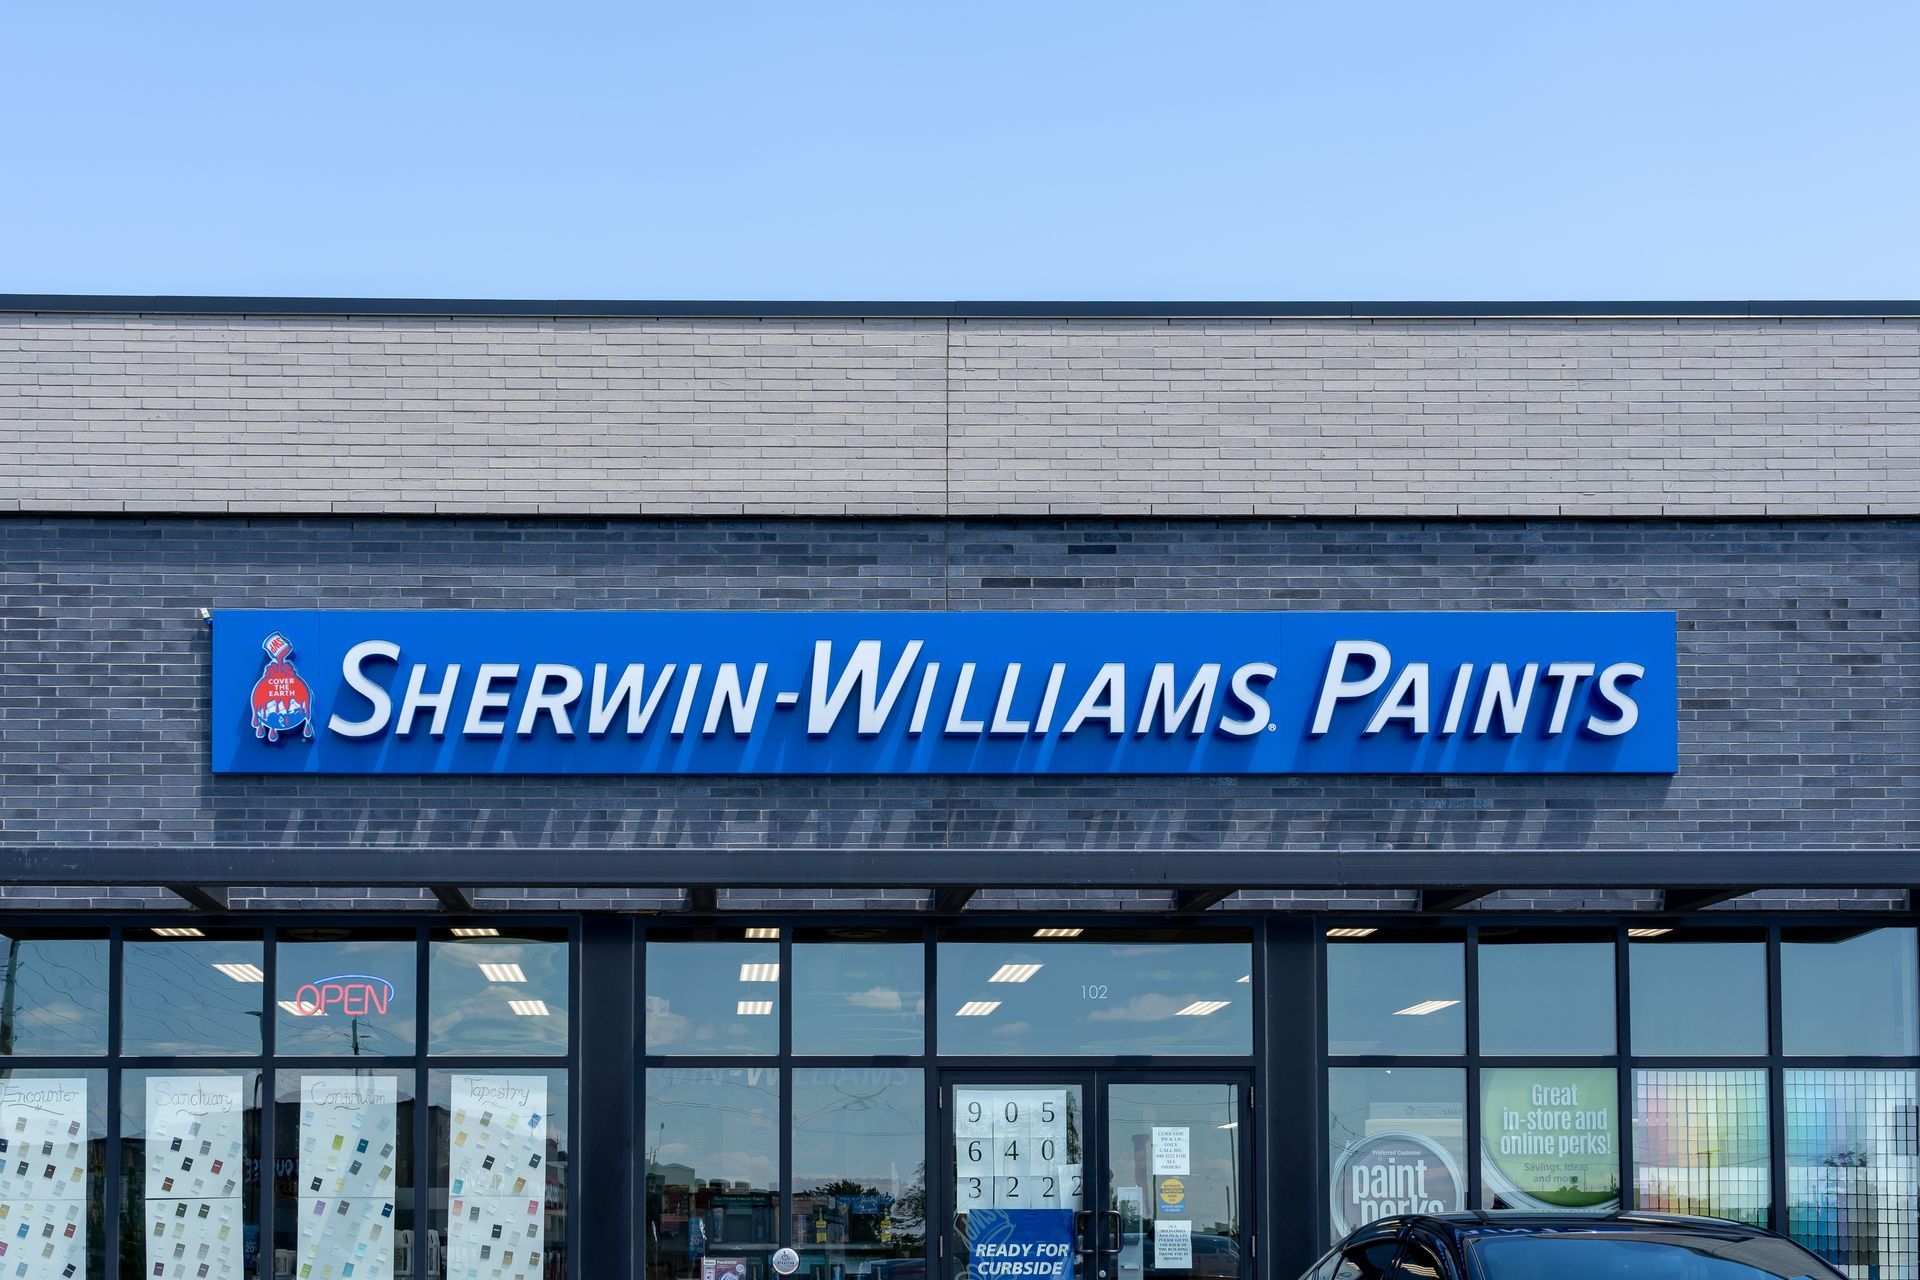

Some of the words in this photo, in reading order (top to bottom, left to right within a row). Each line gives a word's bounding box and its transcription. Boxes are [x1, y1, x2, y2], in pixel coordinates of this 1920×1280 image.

[1311, 639, 1646, 737] PAINTS
[295, 984, 388, 1015] OPEN
[1081, 985, 1109, 999] 102
[1, 1083, 80, 1103] Encounter
[155, 1081, 233, 1113] Sanctuary
[310, 1081, 386, 1105] Continuum
[463, 1076, 530, 1107] Tapestry
[1532, 1084, 1578, 1106] Great
[1503, 1107, 1571, 1131] in-store
[1575, 1107, 1608, 1130] and
[1500, 1131, 1555, 1155] online
[1558, 1132, 1611, 1158] perks!
[1524, 1162, 1562, 1172] Savings,
[1565, 1162, 1589, 1171] ideas
[1533, 1174, 1551, 1182] and
[1352, 1157, 1428, 1204] paint
[975, 1243, 1032, 1257] READY
[1036, 1243, 1069, 1257] FOR
[977, 1261, 1063, 1275] CURBSIDE
